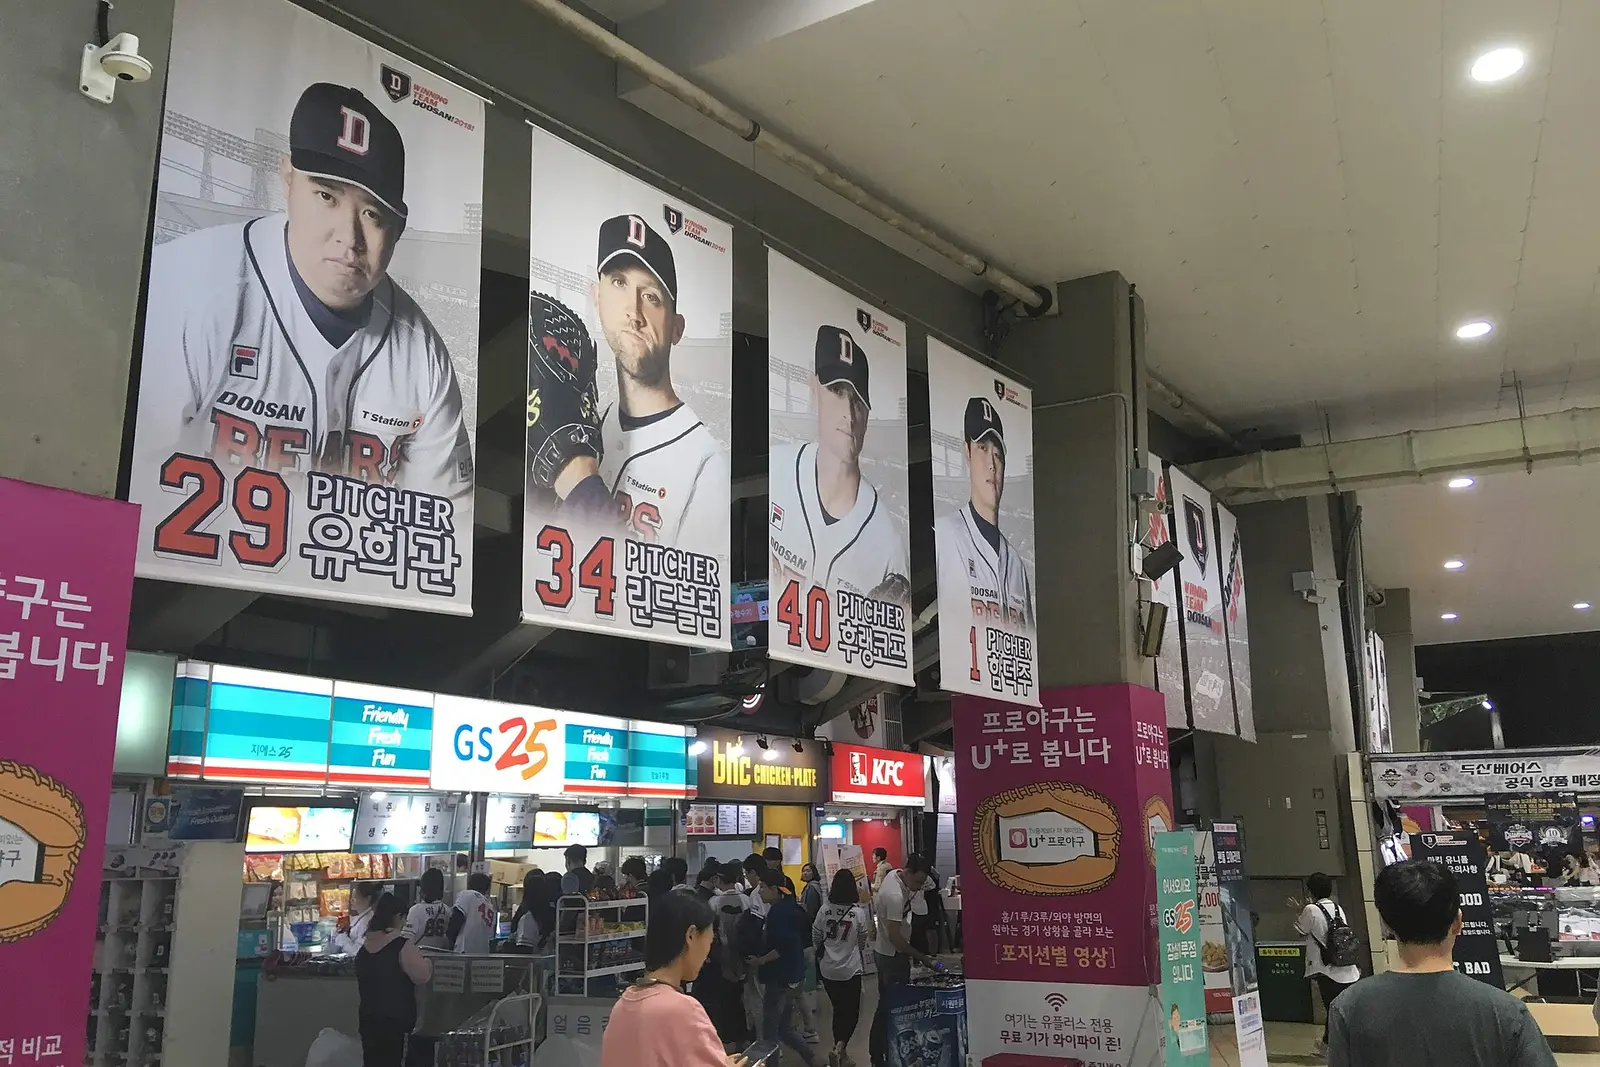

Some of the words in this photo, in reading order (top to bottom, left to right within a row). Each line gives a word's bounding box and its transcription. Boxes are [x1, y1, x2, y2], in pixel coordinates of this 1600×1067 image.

[413, 84, 448, 105] WINNING
[413, 91, 438, 107] TEAM
[337, 104, 371, 156] D
[626, 215, 645, 249] D
[839, 333, 853, 364] D
[216, 391, 306, 422] DOOSAN
[371, 414, 410, 429] Station
[154, 452, 294, 573] 29
[307, 471, 454, 533] PITCHER
[299, 512, 462, 597] 유희관
[625, 539, 719, 587] PITCHER
[535, 525, 618, 621] 34
[0, 575, 92, 630] 구는
[625, 576, 721, 639] 린드블럼
[837, 589, 905, 631] PITCHER
[777, 579, 831, 657] 40
[837, 619, 908, 669] 후랭코프
[970, 626, 981, 684] 1
[986, 627, 1032, 661] PITCHER
[986, 652, 1033, 697] 함덕주
[361, 704, 410, 729] Friendly
[982, 706, 1096, 734] 프로야구는
[368, 727, 402, 746] Fresh
[582, 729, 614, 748] Friendly
[1136, 721, 1164, 746] 프로야구는
[250, 744, 277, 757] 지에스
[278, 746, 293, 759] 25
[372, 748, 396, 767] Fun
[454, 717, 557, 780] GS25
[1040, 737, 1112, 767] 봅니다
[1153, 748, 1169, 770] 봅니다
[713, 740, 751, 786] bhc
[871, 758, 905, 786] KFC
[1505, 777, 1533, 789] 공식
[1539, 775, 1568, 788] 상품
[1047, 836, 1086, 848] 프로야구
[1446, 855, 1469, 865] 유니폼
[1163, 878, 1192, 894] 어서오세요
[826, 919, 853, 942] 37
[1073, 912, 1102, 923] 방면의
[1164, 900, 1195, 934] GS25
[992, 925, 1018, 936] 원하는
[1022, 926, 1040, 937] 경기
[1043, 926, 1070, 938] 상황을
[1073, 926, 1092, 938] 골라
[1095, 927, 1114, 938] 보는
[1172, 963, 1194, 984] 입니다
[1464, 961, 1491, 975] BAD
[1005, 1013, 1038, 1029] 여기는
[1042, 1014, 1087, 1031] 유플러스
[1090, 1017, 1114, 1033] 전용
[22, 1035, 62, 1061] 비교
[1000, 1031, 1022, 1043] 무료
[1026, 1032, 1049, 1044] 기가
[1053, 1034, 1100, 1049] 와이파이
[1105, 1037, 1121, 1052] 존!
